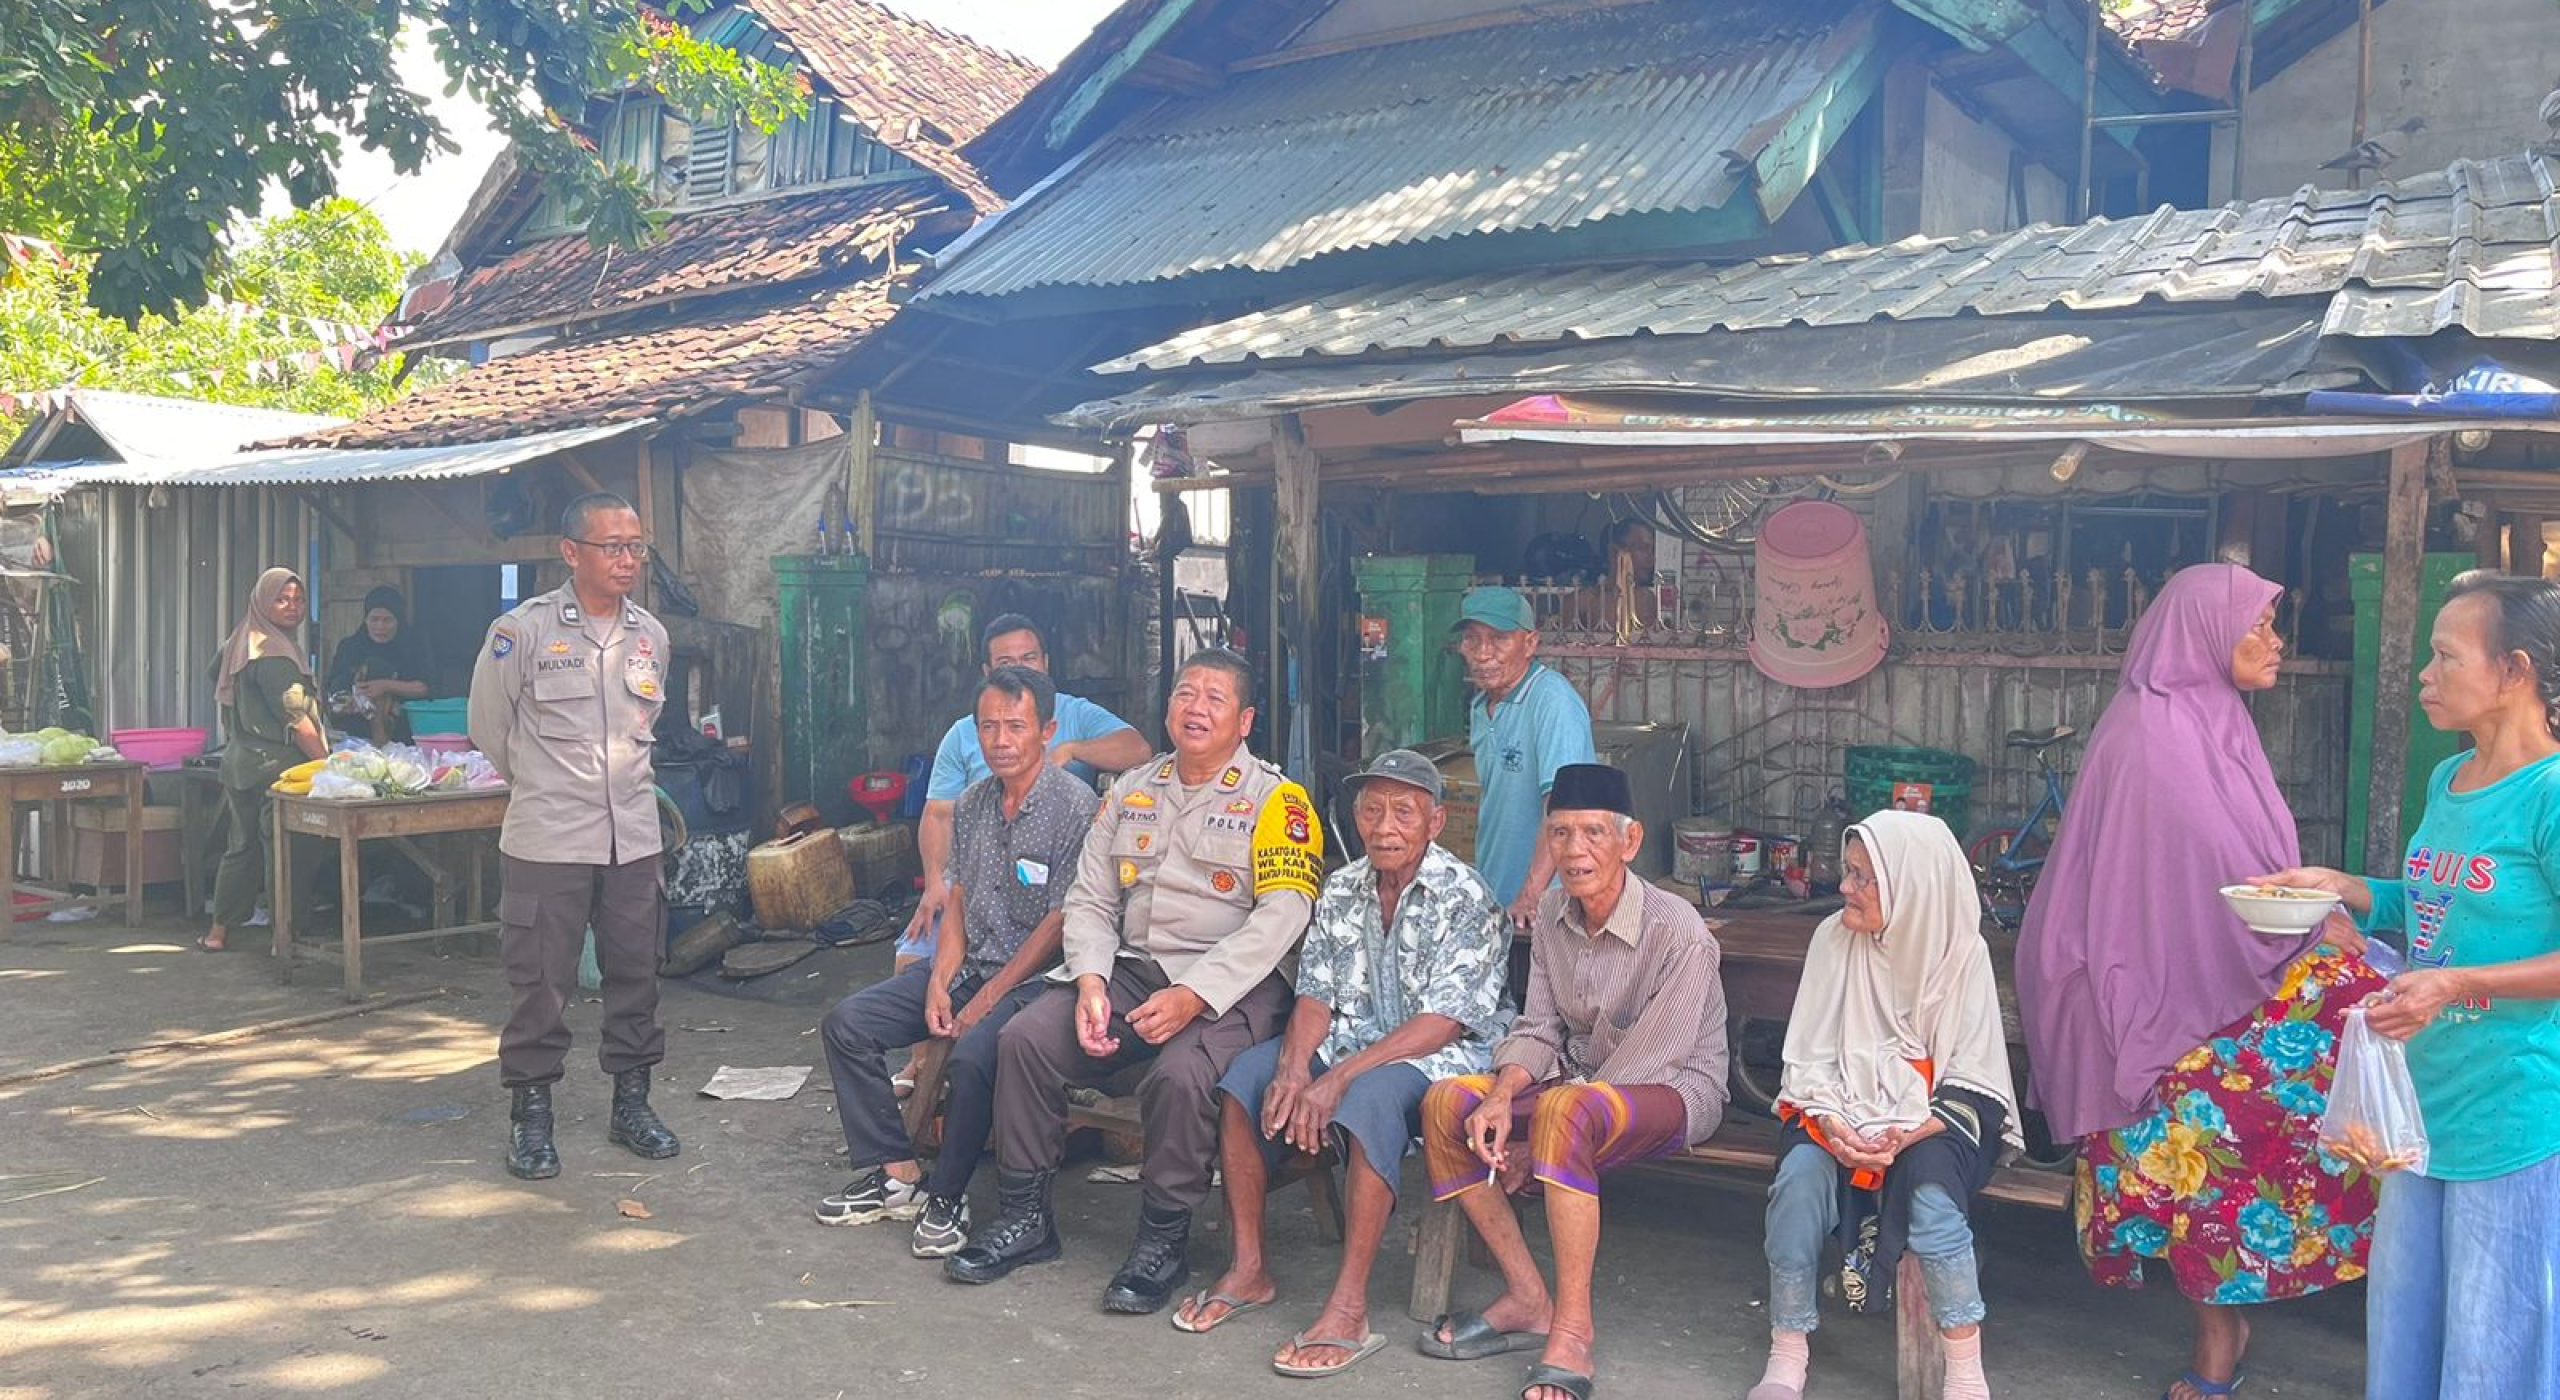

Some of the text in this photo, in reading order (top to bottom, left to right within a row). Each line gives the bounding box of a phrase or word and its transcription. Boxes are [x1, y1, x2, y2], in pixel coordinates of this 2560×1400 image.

[538, 657, 585, 671] MULYADI
[1257, 846, 1301, 858] KASATGAS
[1257, 859, 1277, 869] WIL
